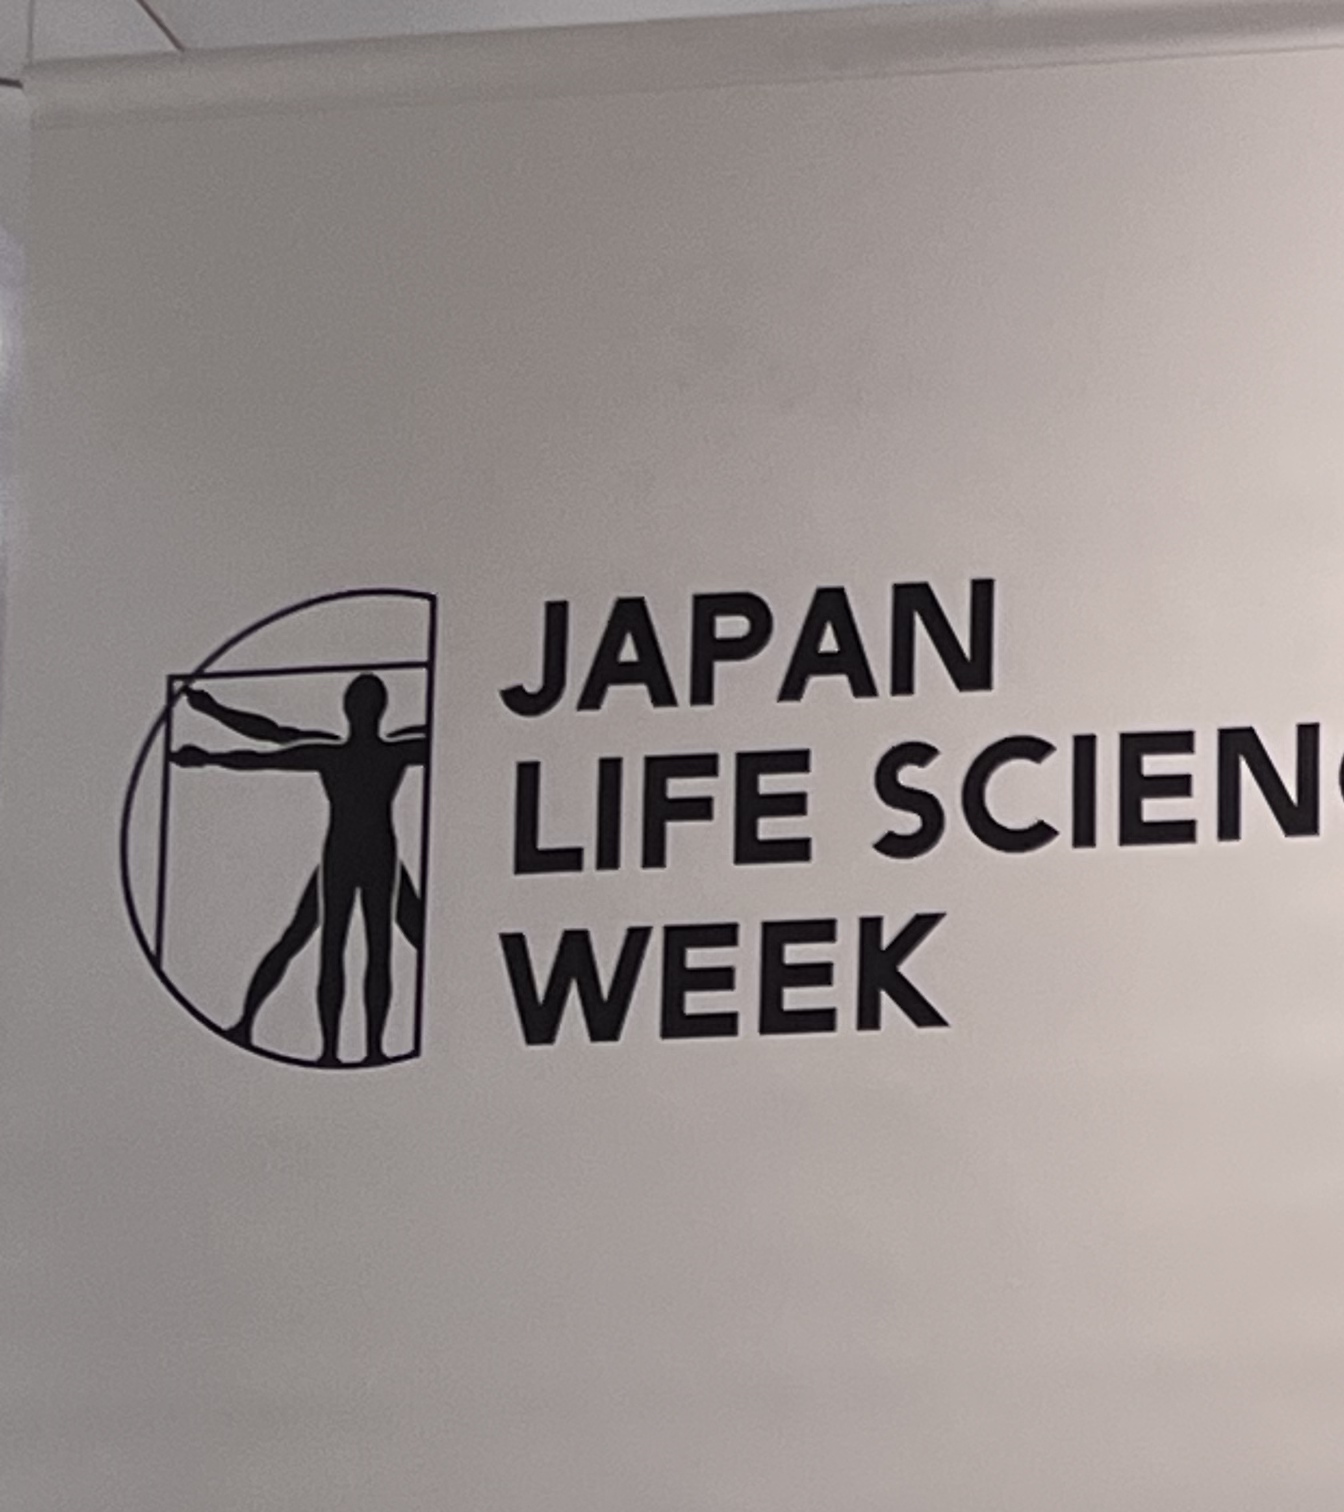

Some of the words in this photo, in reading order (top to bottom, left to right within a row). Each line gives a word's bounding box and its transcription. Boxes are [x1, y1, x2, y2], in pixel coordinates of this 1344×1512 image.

[500, 577, 996, 717] JAPAN
[513, 748, 813, 876] LIFE
[498, 911, 950, 1046] WEEK
